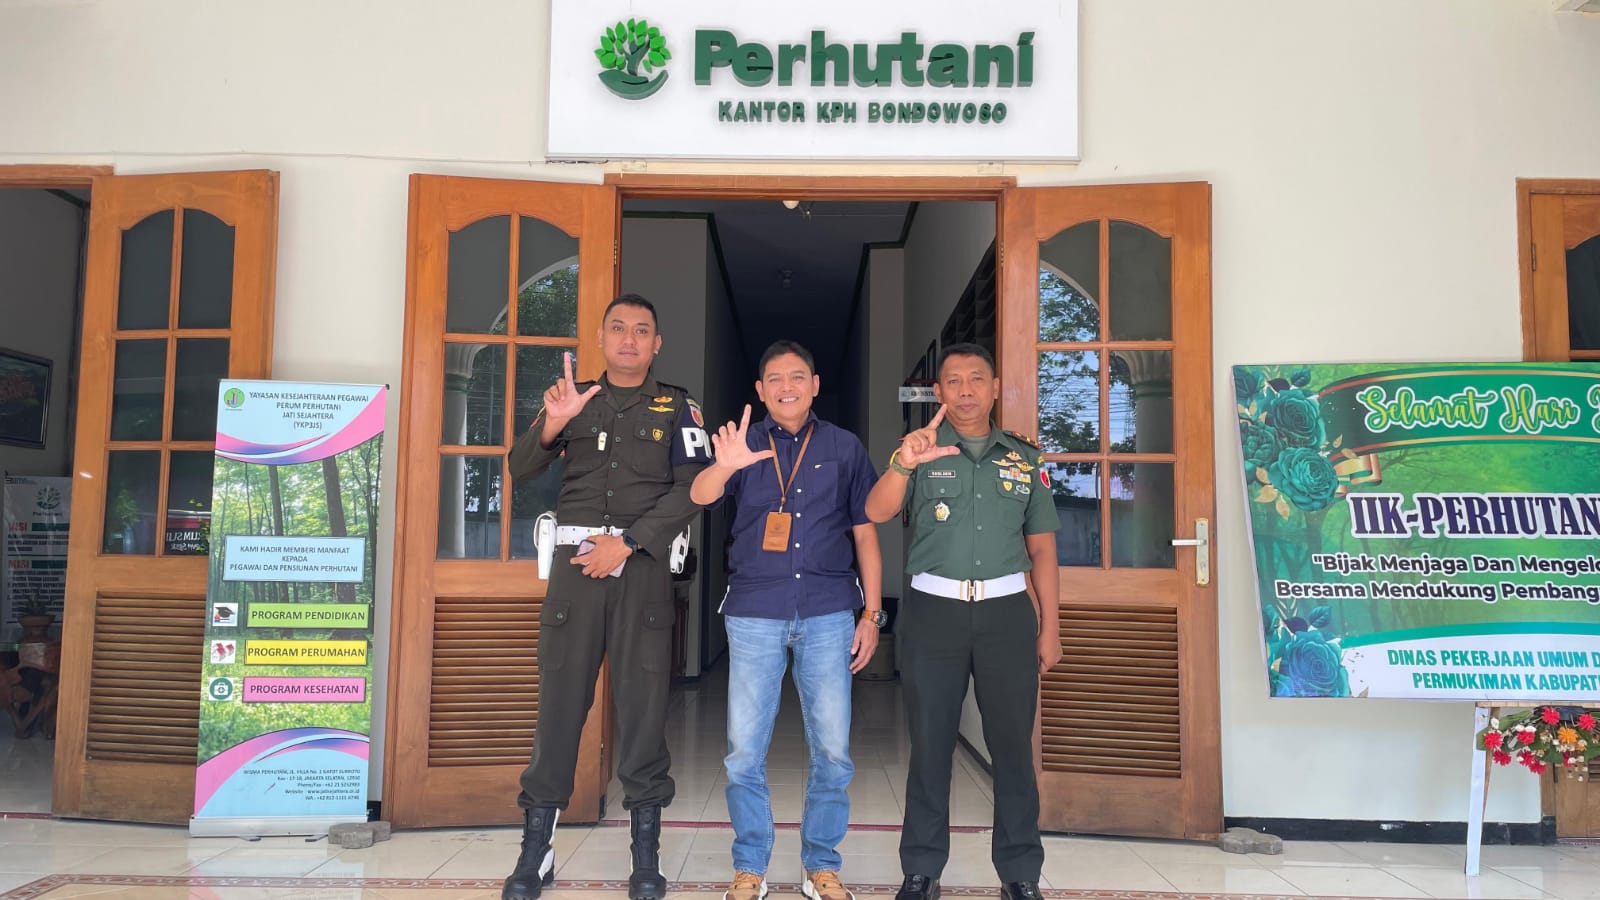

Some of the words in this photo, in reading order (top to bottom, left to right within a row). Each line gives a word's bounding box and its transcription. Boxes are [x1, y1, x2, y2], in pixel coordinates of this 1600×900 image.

[695, 29, 1035, 88] Perhutani
[718, 101, 805, 123] KANTOR
[816, 102, 857, 124] KPH
[868, 102, 1008, 125] BONDOWOSO
[249, 391, 280, 399] YAYASAN
[281, 392, 336, 401] KESEJAHTERAAN
[337, 394, 369, 402] PEGAWAI
[302, 403, 341, 411] PERHUTANI
[1358, 386, 1496, 432] Selamat
[1501, 385, 1579, 433] Hari
[282, 411, 296, 419] JATI
[296, 412, 334, 420] SEJAHTERA
[1349, 496, 1600, 536] IIK-PERHUTAN
[240, 545, 259, 553] KAMI
[283, 546, 316, 554] MEMBERI
[317, 546, 350, 554] MANFAAT
[230, 563, 261, 571] PEGAWAI
[279, 564, 319, 572] PENSIUNAN
[1314, 555, 1374, 575] "Bijak
[1381, 556, 1467, 575] Menjaga
[1474, 556, 1516, 572] Dan
[1276, 581, 1366, 598] Bersama
[1371, 582, 1496, 602] Mendukung
[1502, 582, 1600, 603] Pembang
[251, 610, 302, 620] PROGRAM
[305, 611, 365, 621] PENDIDIKAN
[247, 647, 299, 657] PROGRAM
[301, 648, 365, 657] PERUMAHAN
[1388, 649, 1437, 666] DINAS
[1441, 651, 1534, 668] PEKERJAAN
[1537, 651, 1589, 668] UMUM
[250, 684, 301, 694] PROGRAM
[303, 685, 359, 694] KESEHATAN
[1413, 672, 1522, 690] PERMUKIMAN
[1525, 674, 1600, 691] KABUPAT
